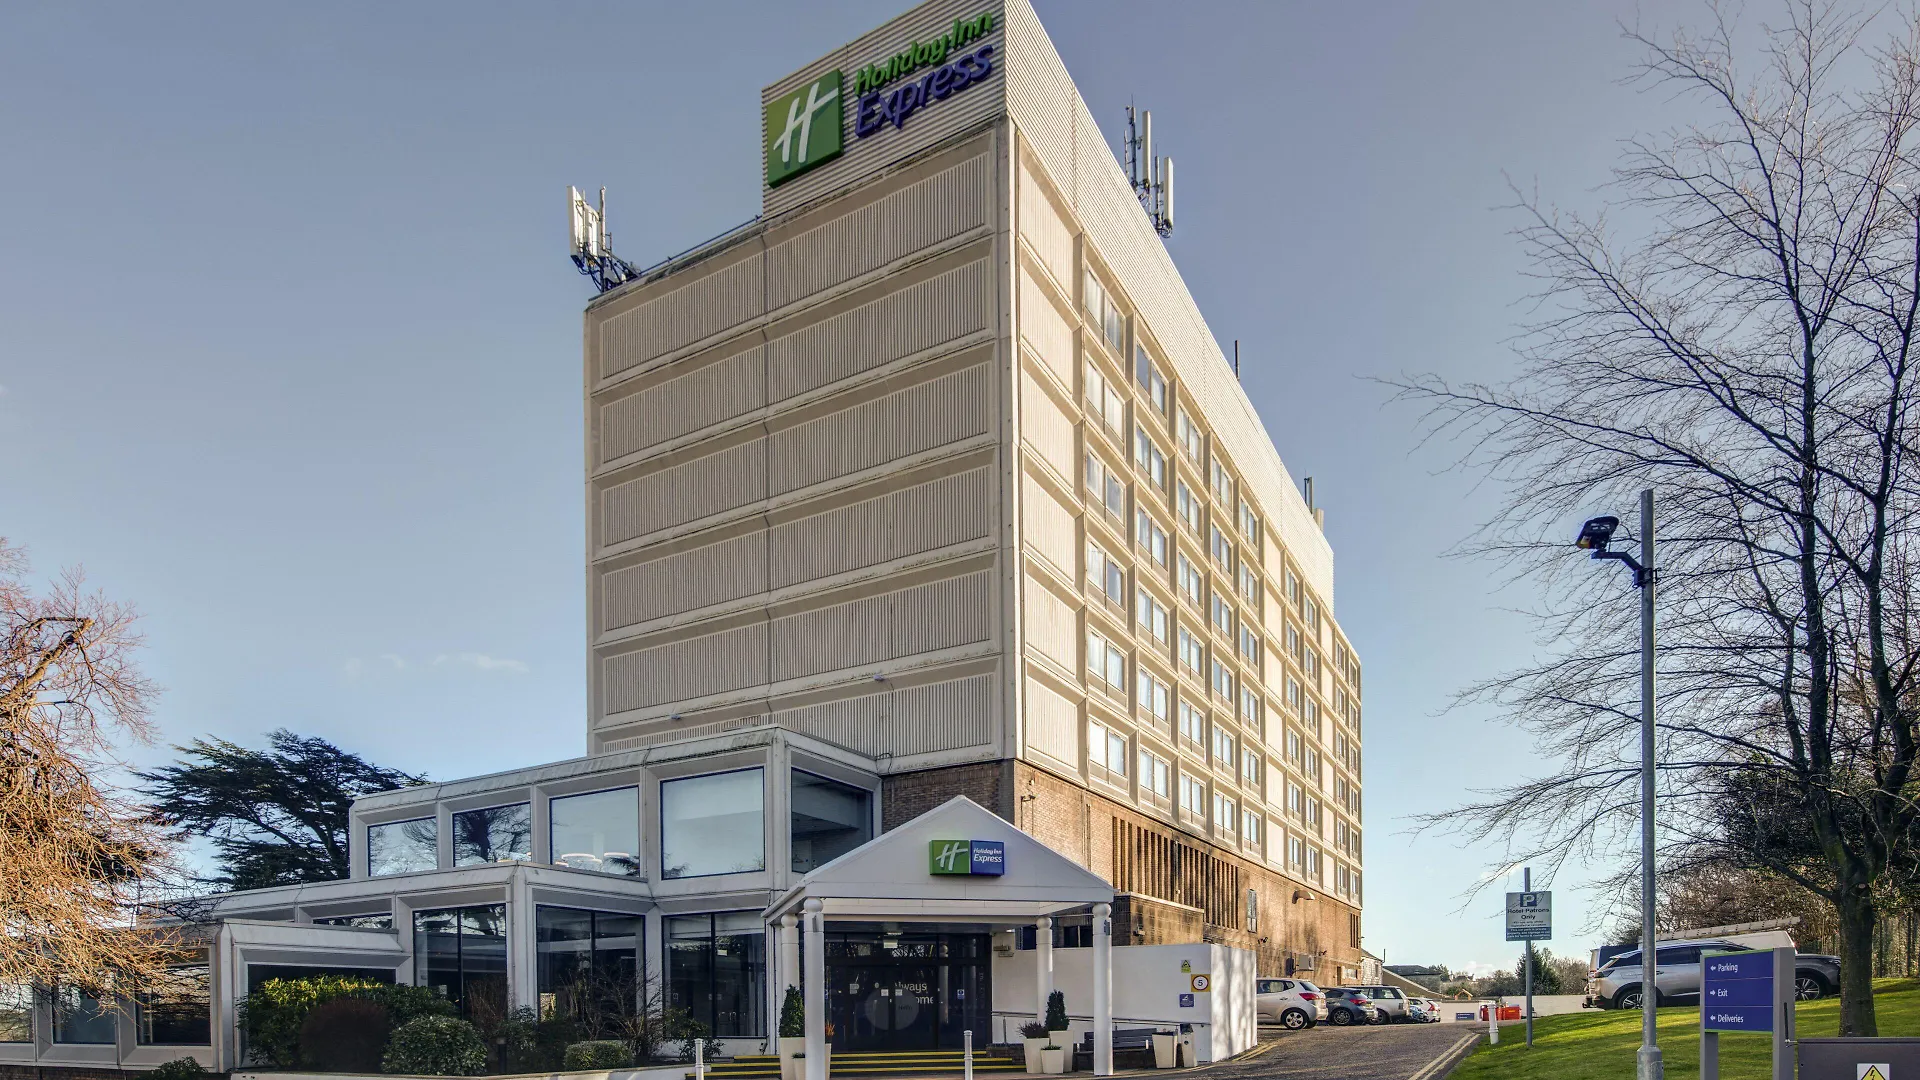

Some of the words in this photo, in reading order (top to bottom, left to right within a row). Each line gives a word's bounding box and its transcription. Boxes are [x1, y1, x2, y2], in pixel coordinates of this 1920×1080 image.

[854, 33, 950, 96] Holiday
[950, 11, 993, 49] Inn
[855, 44, 994, 137] Express
[973, 847, 993, 855] Holiday
[973, 854, 1002, 863] Express
[1523, 894, 1535, 906] P
[1717, 962, 1738, 973] Parking
[895, 981, 927, 994] lways
[1197, 979, 1204, 987] 5
[1717, 988, 1728, 997] Exit
[1717, 1013, 1744, 1023] Deliveries
